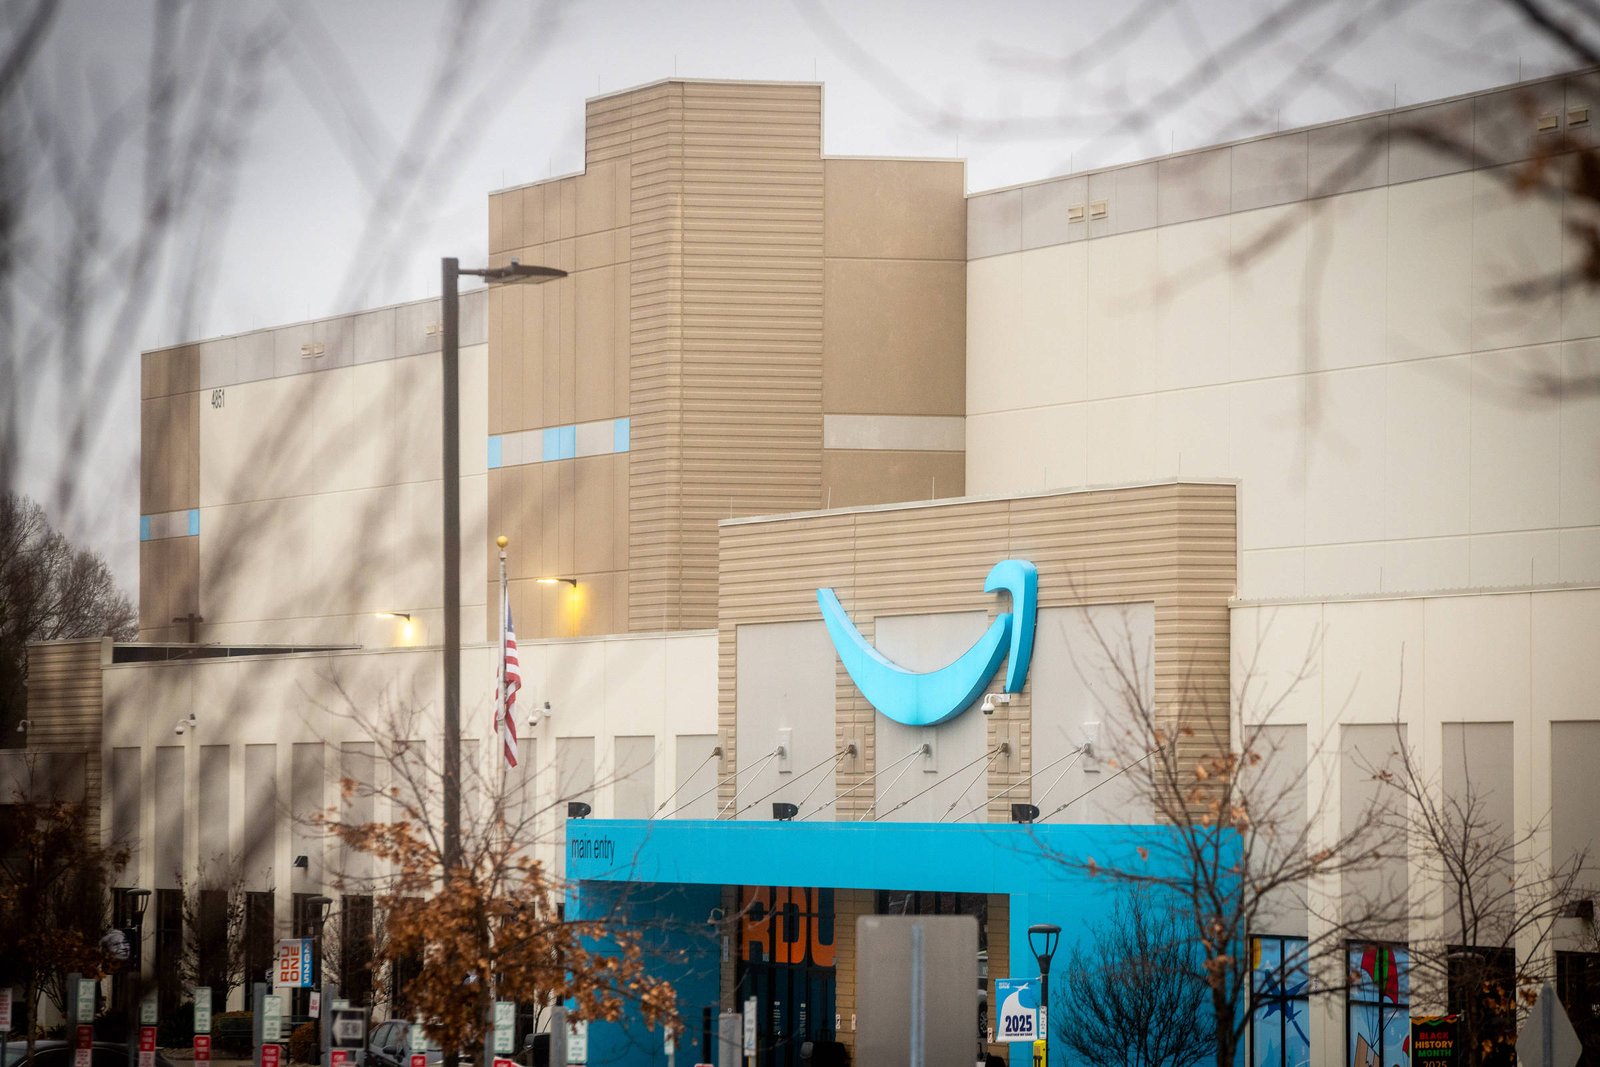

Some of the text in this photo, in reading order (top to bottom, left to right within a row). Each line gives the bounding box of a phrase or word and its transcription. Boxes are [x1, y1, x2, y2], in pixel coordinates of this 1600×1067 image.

[211, 388, 225, 409] 4851
[571, 832, 615, 866] main entry
[742, 886, 836, 966] RDU
[281, 946, 290, 982] RDU
[290, 946, 299, 982] ONE
[303, 943, 311, 983] 2025
[1005, 1015, 1032, 1032] 2025
[1419, 1031, 1449, 1040] BLACK
[1415, 1041, 1454, 1049] HISTORY
[1417, 1049, 1452, 1057] MONTH
